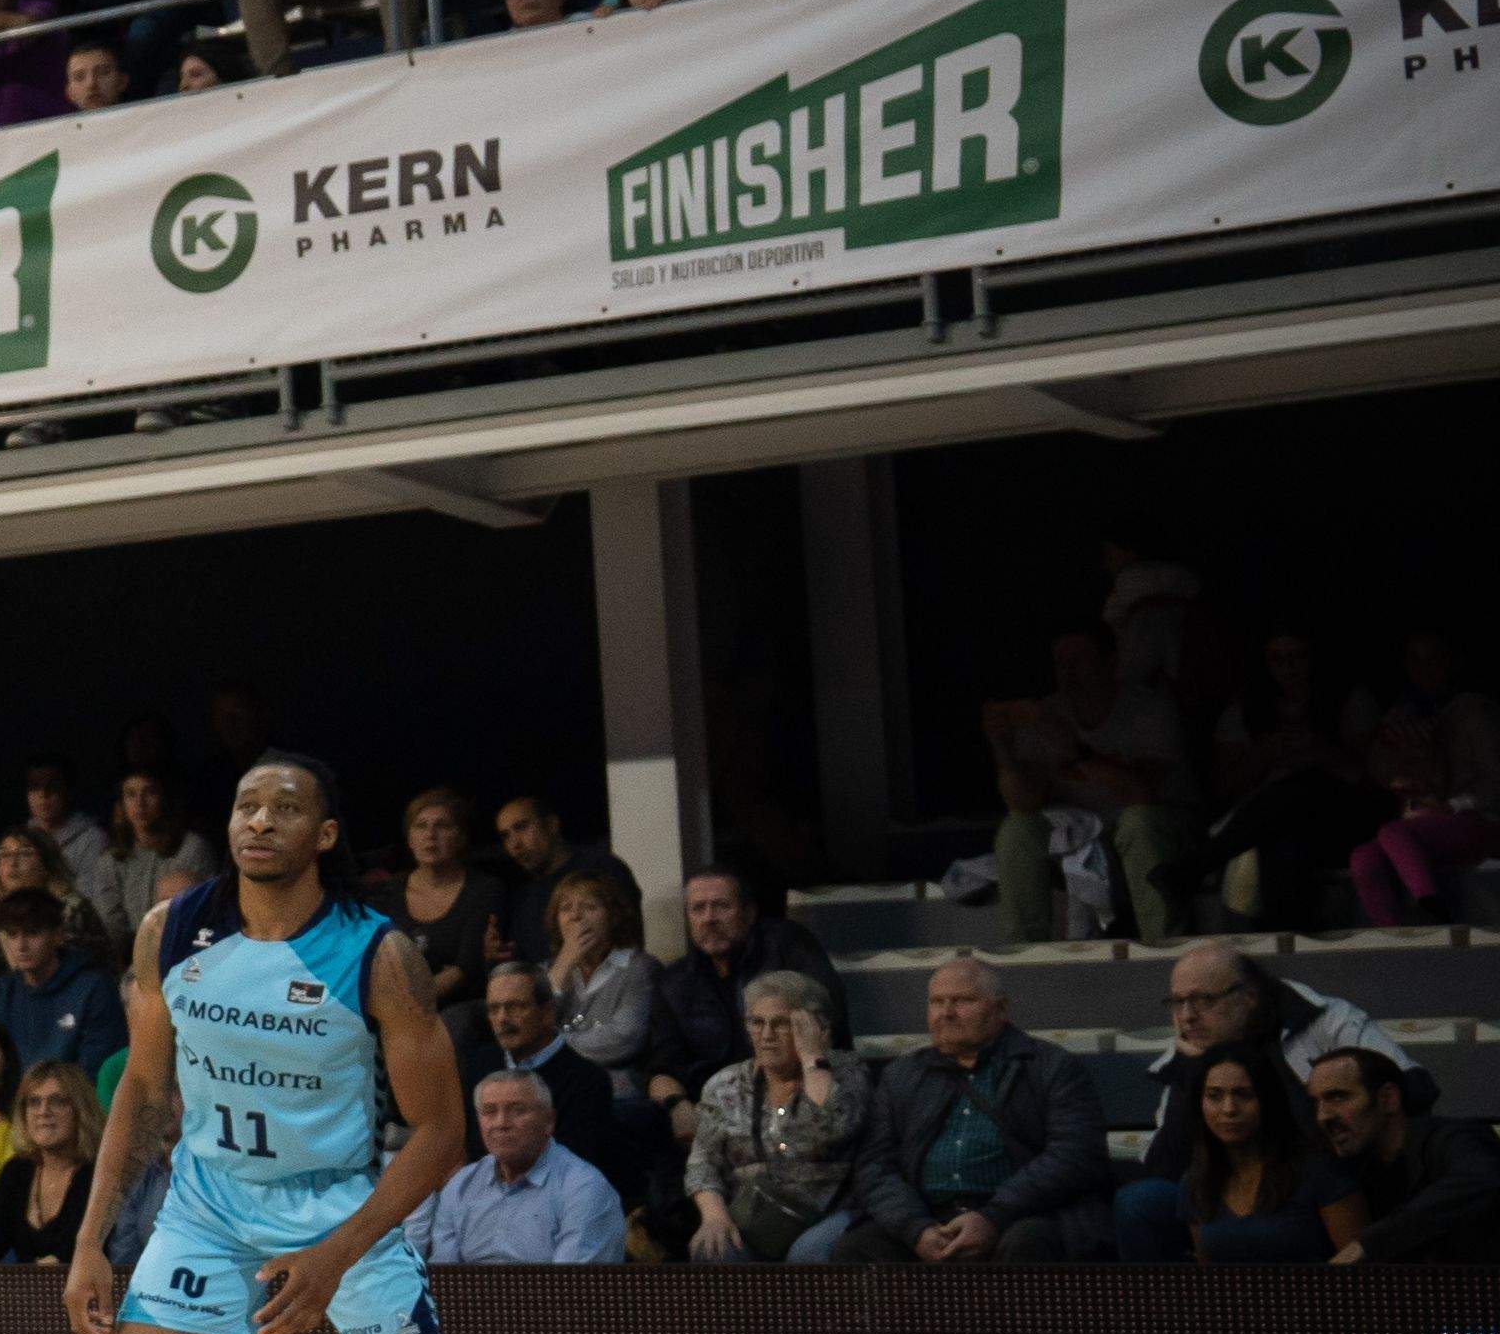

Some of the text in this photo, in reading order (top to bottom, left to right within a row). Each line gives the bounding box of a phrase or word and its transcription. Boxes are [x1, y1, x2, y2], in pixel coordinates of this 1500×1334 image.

[622, 32, 1024, 251] FINISHER
[294, 138, 503, 223] KERN
[297, 208, 506, 258] PHARMA
[748, 240, 825, 270] DEPORTIVA
[188, 1001, 329, 1037] MORABANC
[202, 1054, 323, 1091] Andorra
[215, 1104, 277, 1159] 11
